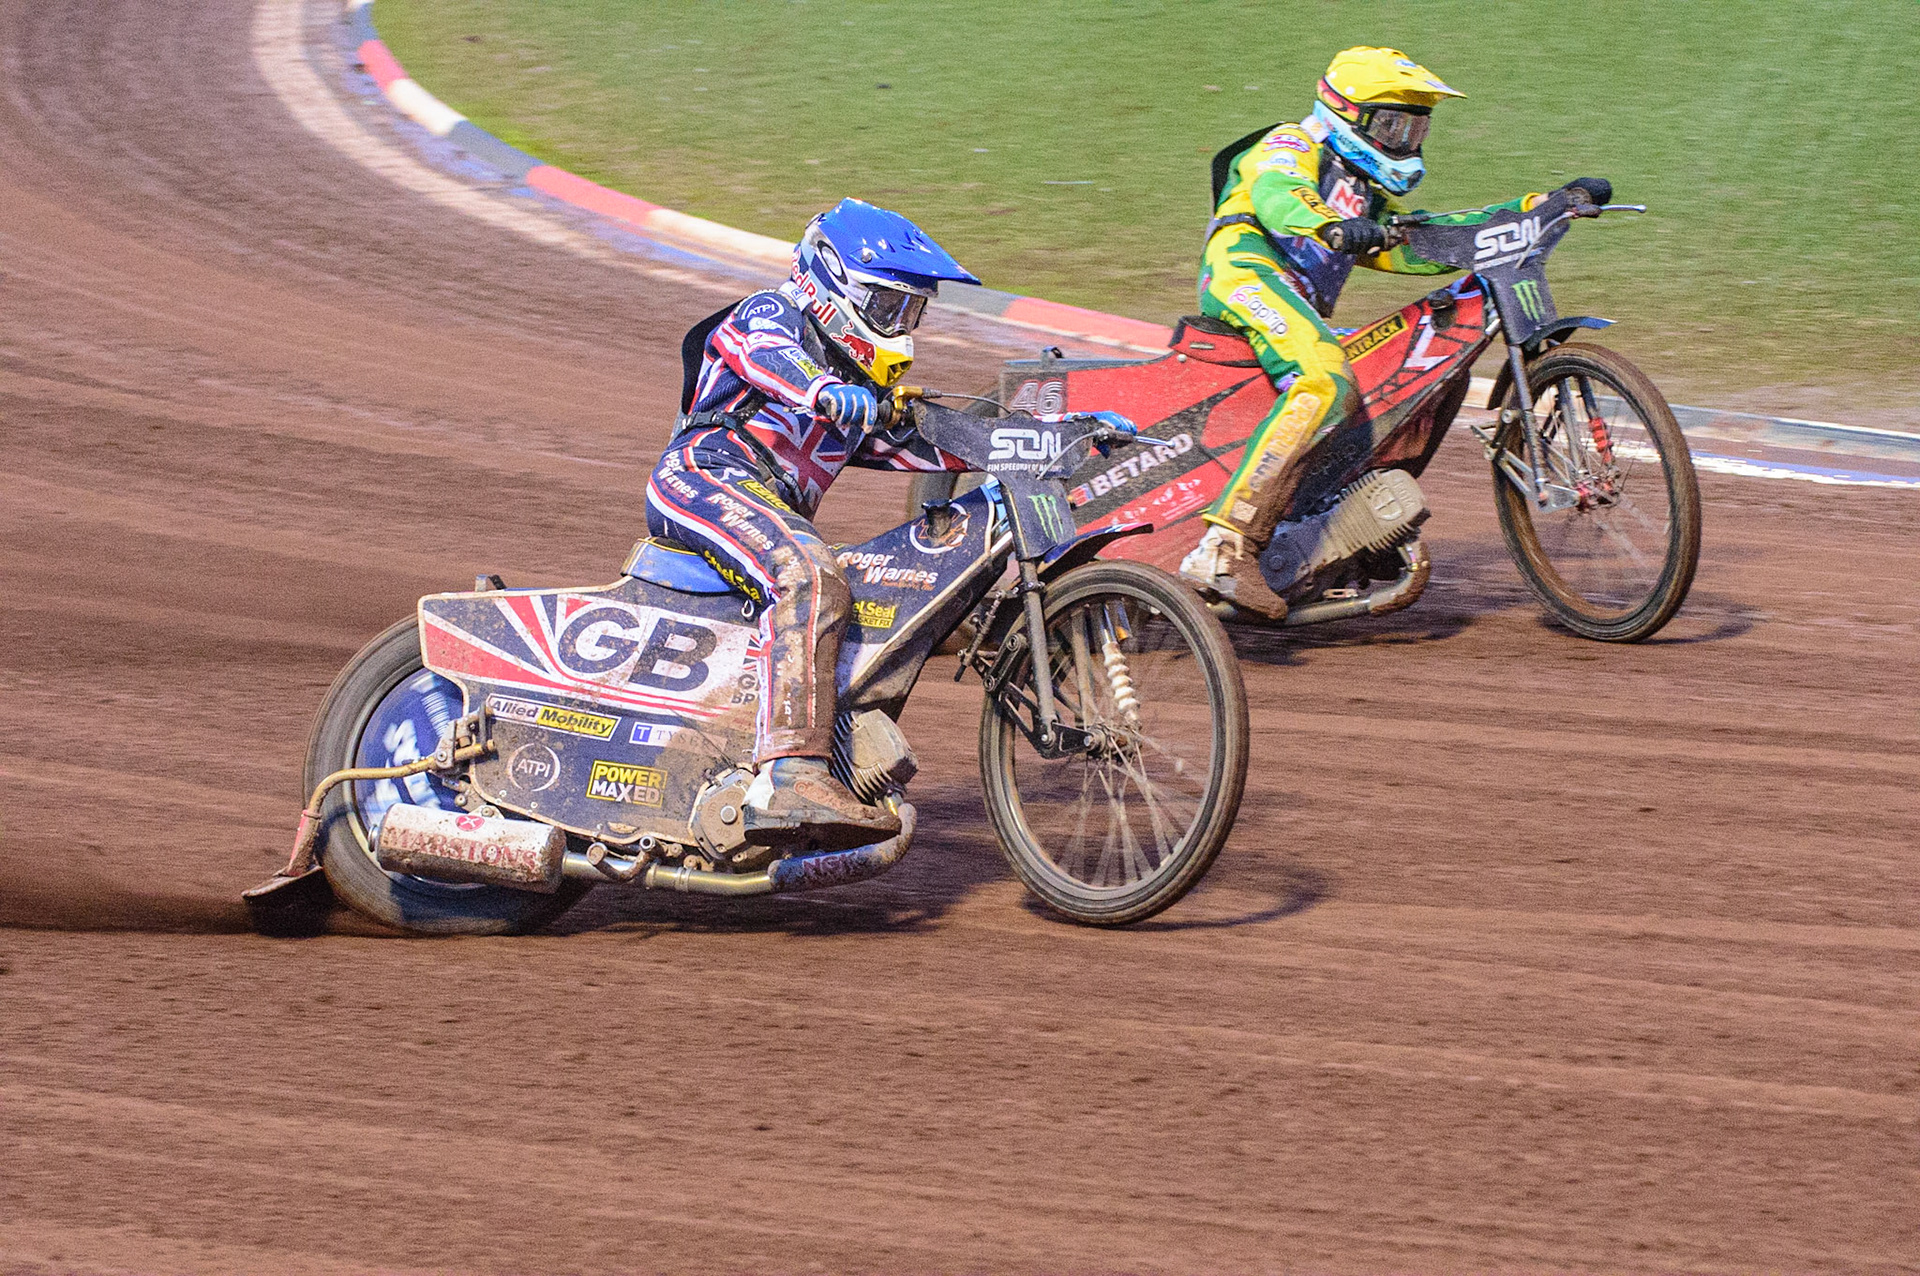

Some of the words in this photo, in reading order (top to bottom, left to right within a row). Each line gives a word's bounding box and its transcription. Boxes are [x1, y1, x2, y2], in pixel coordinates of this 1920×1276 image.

[747, 303, 776, 319] ATPI
[1345, 318, 1400, 360] NTRACK
[1009, 379, 1064, 415] 46
[987, 463, 1000, 472] FIM
[1088, 433, 1194, 497] BETARD
[707, 492, 756, 520] Roger
[837, 551, 895, 569] Roger
[863, 566, 939, 585] Warnes
[866, 601, 896, 619] Seal
[559, 607, 717, 692] GB
[492, 700, 540, 718] Allied
[541, 708, 613, 735] Mobility
[515, 758, 551, 778] ATPI
[594, 765, 662, 787] POWER
[590, 779, 662, 803] MAXED
